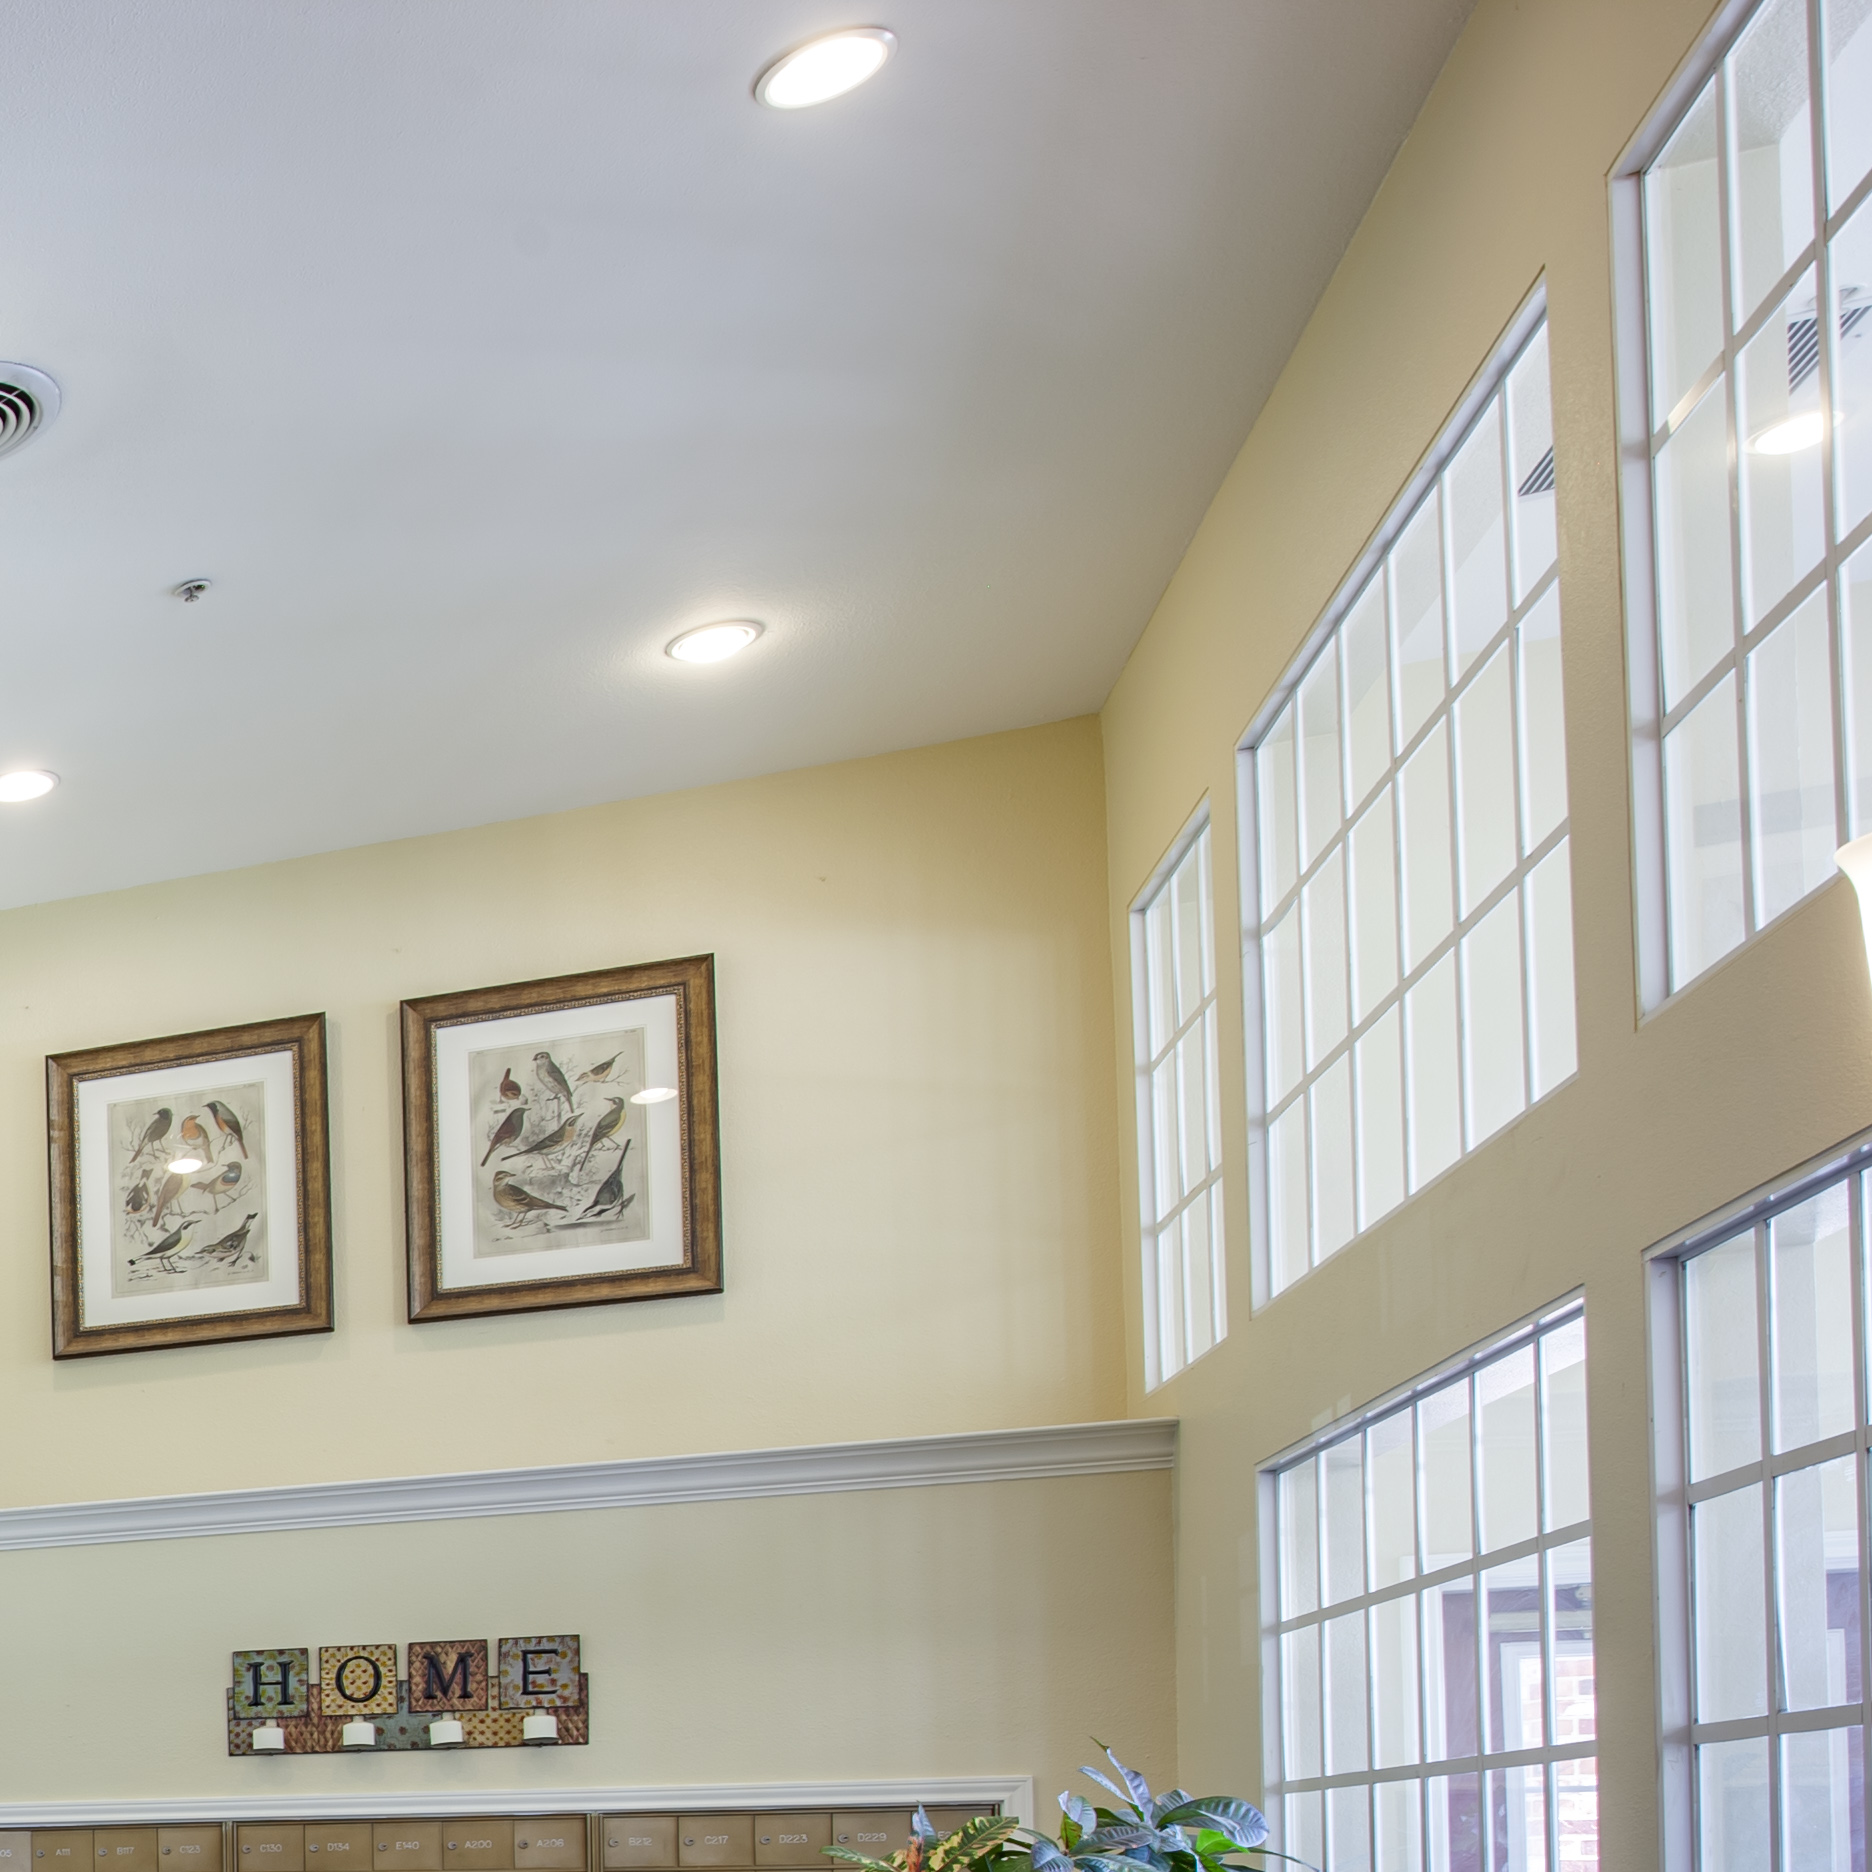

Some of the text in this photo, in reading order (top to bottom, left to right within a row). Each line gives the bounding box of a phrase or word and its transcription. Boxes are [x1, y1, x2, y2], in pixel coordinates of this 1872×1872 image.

[246, 1648, 560, 1707] HOME
[628, 1837, 653, 1846] B212
[704, 1835, 729, 1845] C217
[778, 1834, 809, 1844] D223
[856, 1832, 888, 1843] D229
[179, 1845, 201, 1854] C123
[326, 1842, 350, 1852] D134
[395, 1841, 421, 1851] E140
[464, 1840, 493, 1849] A200
[55, 1848, 71, 1856] A111
[116, 1847, 135, 1855] B117
